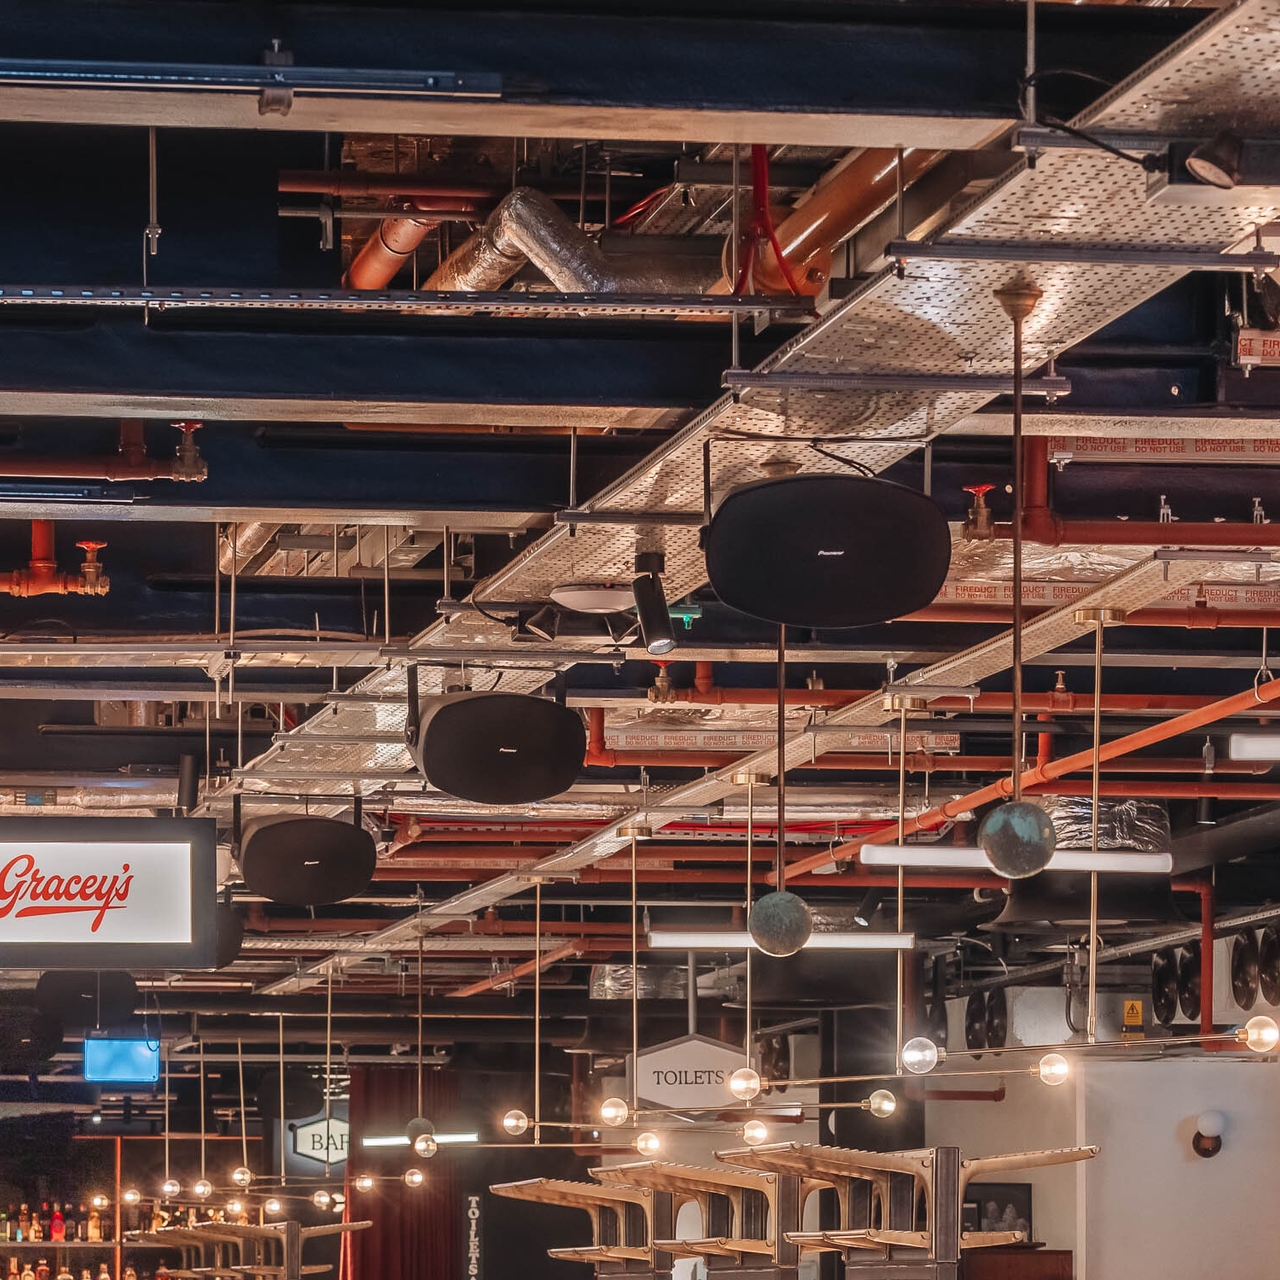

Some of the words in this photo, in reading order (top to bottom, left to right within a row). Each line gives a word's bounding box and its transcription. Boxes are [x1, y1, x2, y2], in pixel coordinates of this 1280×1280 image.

[1240, 348, 1254, 356] SE
[1135, 438, 1186, 446] FIREDUCT
[1195, 438, 1246, 446] FIREDUCT
[1090, 444, 1108, 452] NOT
[652, 1070, 725, 1086] TOILETS
[468, 1196, 480, 1275] TOILETS
